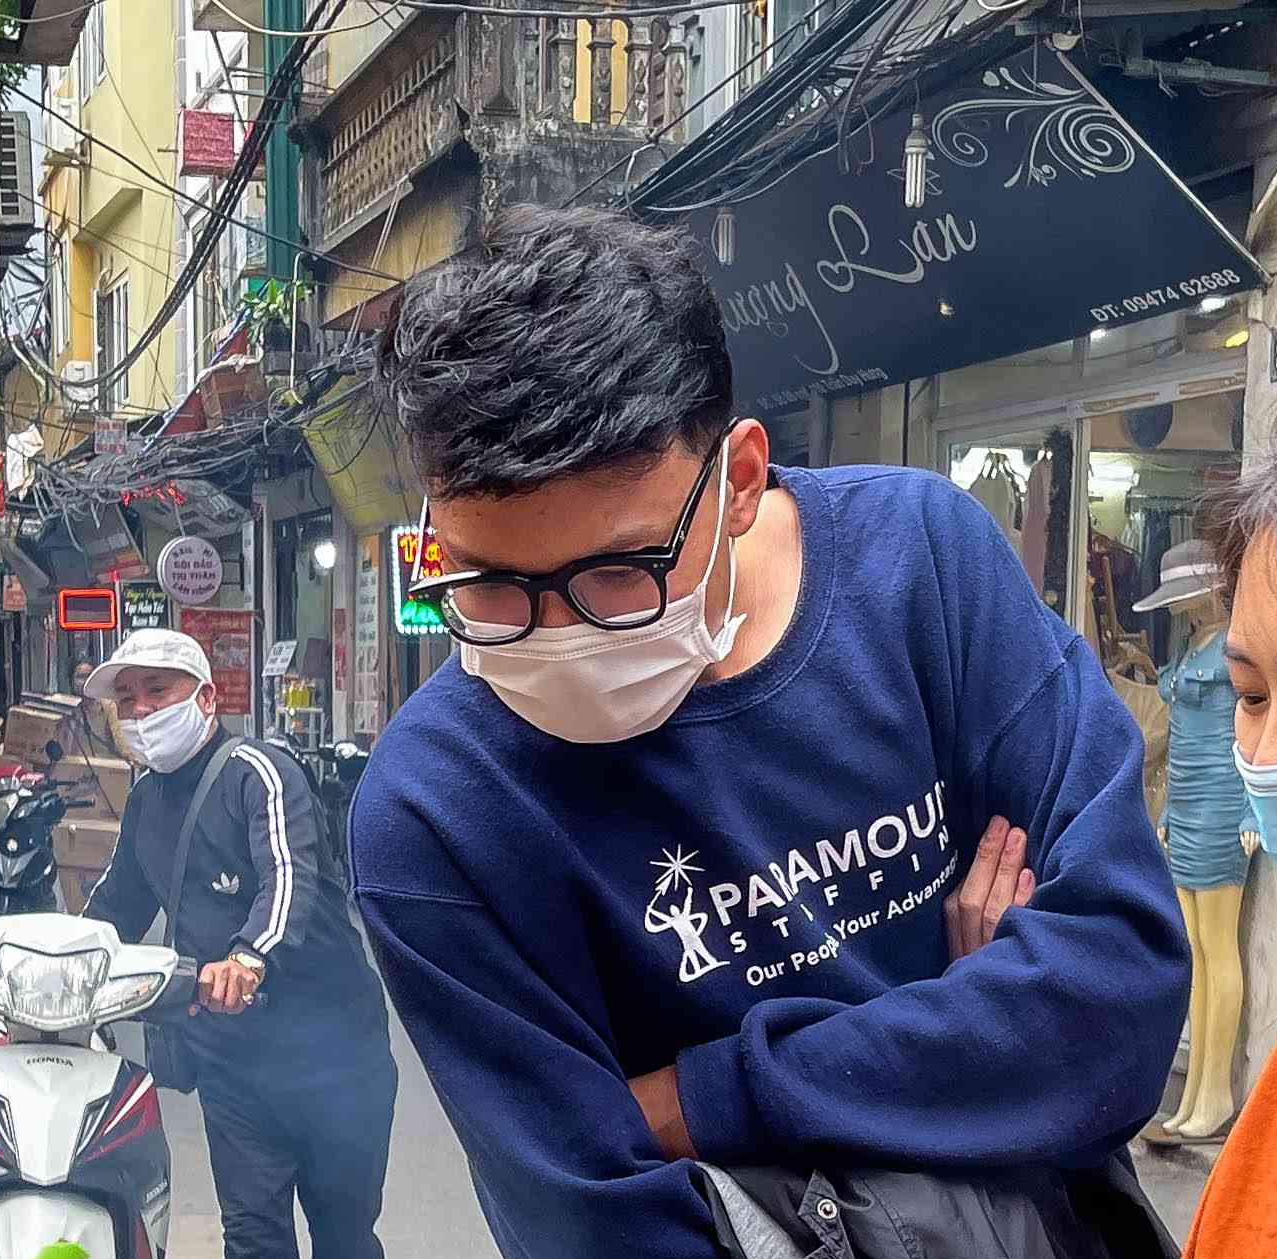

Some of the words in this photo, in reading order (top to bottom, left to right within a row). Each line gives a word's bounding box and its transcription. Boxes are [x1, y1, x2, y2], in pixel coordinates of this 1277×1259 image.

[816, 203, 978, 294] Lan
[1124, 286, 1181, 313] 09474
[1180, 268, 1241, 297] 62688
[746, 957, 785, 987] Our
[833, 909, 880, 941] Your
